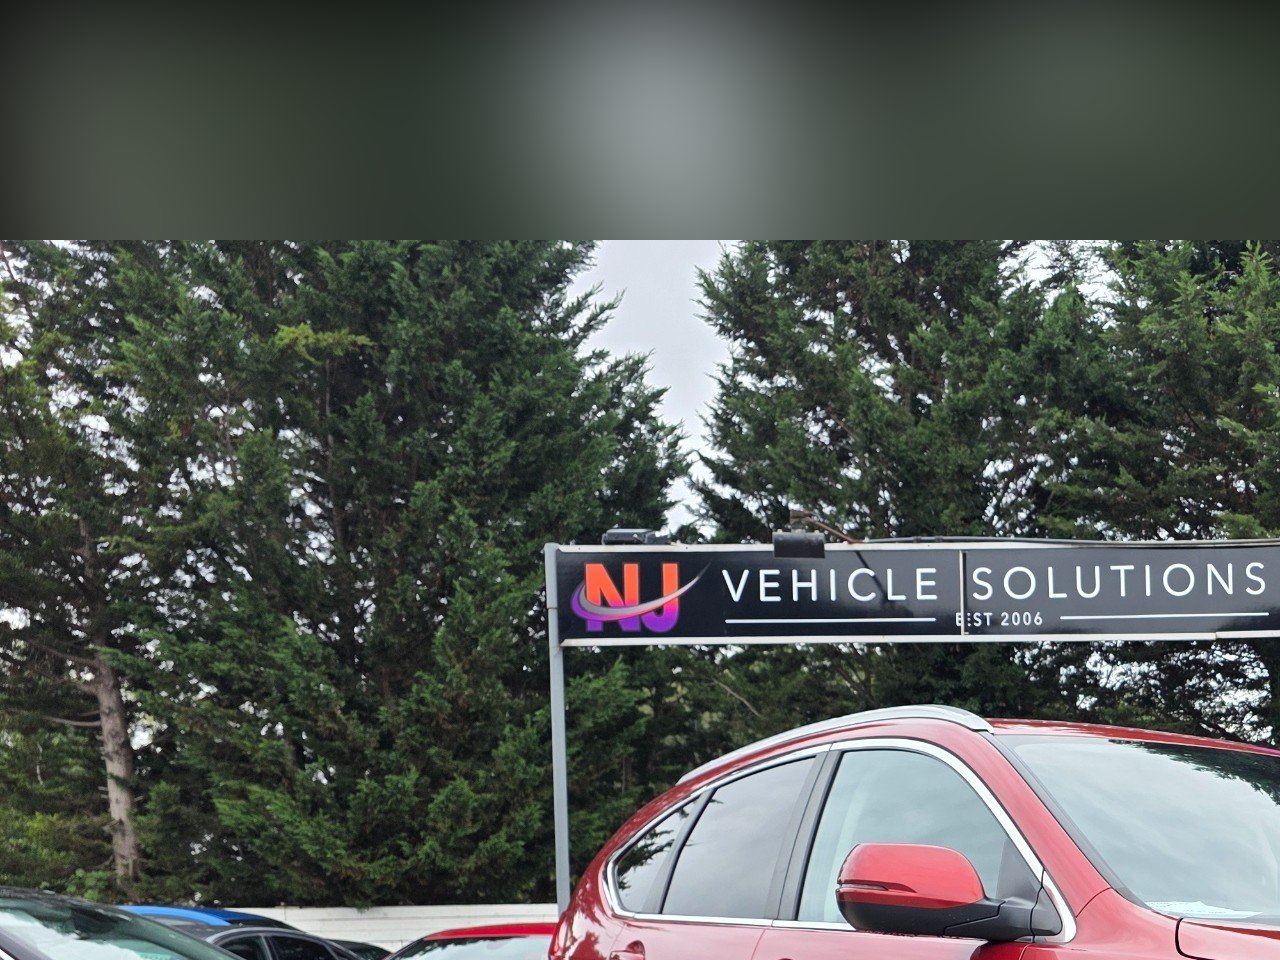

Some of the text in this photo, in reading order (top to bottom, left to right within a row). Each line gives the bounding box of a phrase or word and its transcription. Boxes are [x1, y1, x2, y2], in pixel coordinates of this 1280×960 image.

[585, 563, 680, 633] NJ
[721, 561, 1267, 602] VEHICLE SOLUTIONS
[955, 611, 1043, 627] EST 2006
